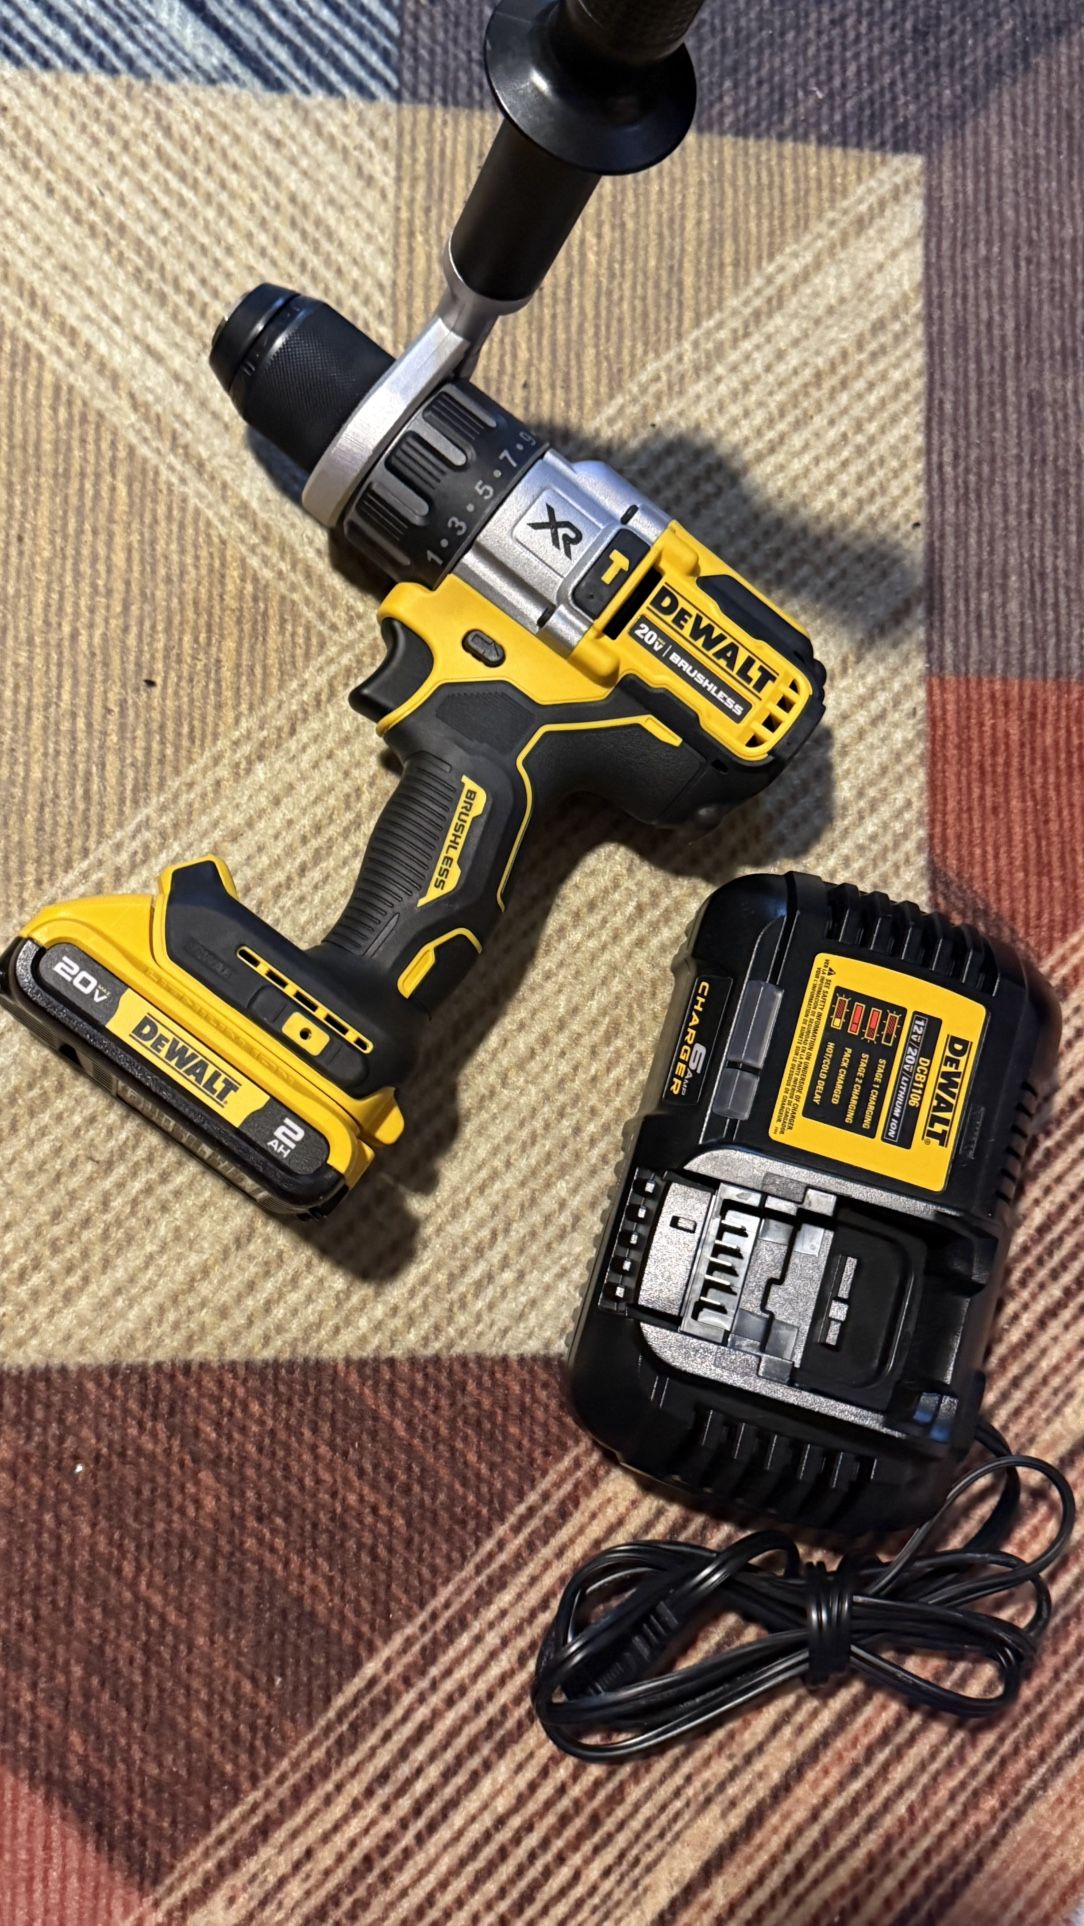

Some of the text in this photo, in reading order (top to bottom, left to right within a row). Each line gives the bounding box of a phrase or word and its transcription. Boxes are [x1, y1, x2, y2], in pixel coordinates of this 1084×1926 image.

[427, 550, 443, 565] 1
[448, 516, 467, 535] 3
[474, 480, 493, 500] 5
[499, 450, 517, 467] 7
[527, 503, 583, 560] XR
[669, 652, 743, 715] BRUSHLESS
[434, 789, 477, 890] BRUSHLESS
[670, 982, 709, 1094] CHARGER
[807, 1010, 823, 1051] INFORMATION
[812, 1040, 835, 1105] HOT/COLD DELAY
[830, 1046, 852, 1105] PACK CHARGED
[855, 1052, 869, 1078] STAGE
[873, 1057, 887, 1083] STAGE
[909, 1057, 930, 1107] DCB1106
[844, 1082, 862, 1124] CHARGING
[861, 1088, 879, 1130] CHARGING
[267, 1139, 290, 1158] AH
[274, 1118, 304, 1149] 2
[886, 1117, 898, 1138] ION
